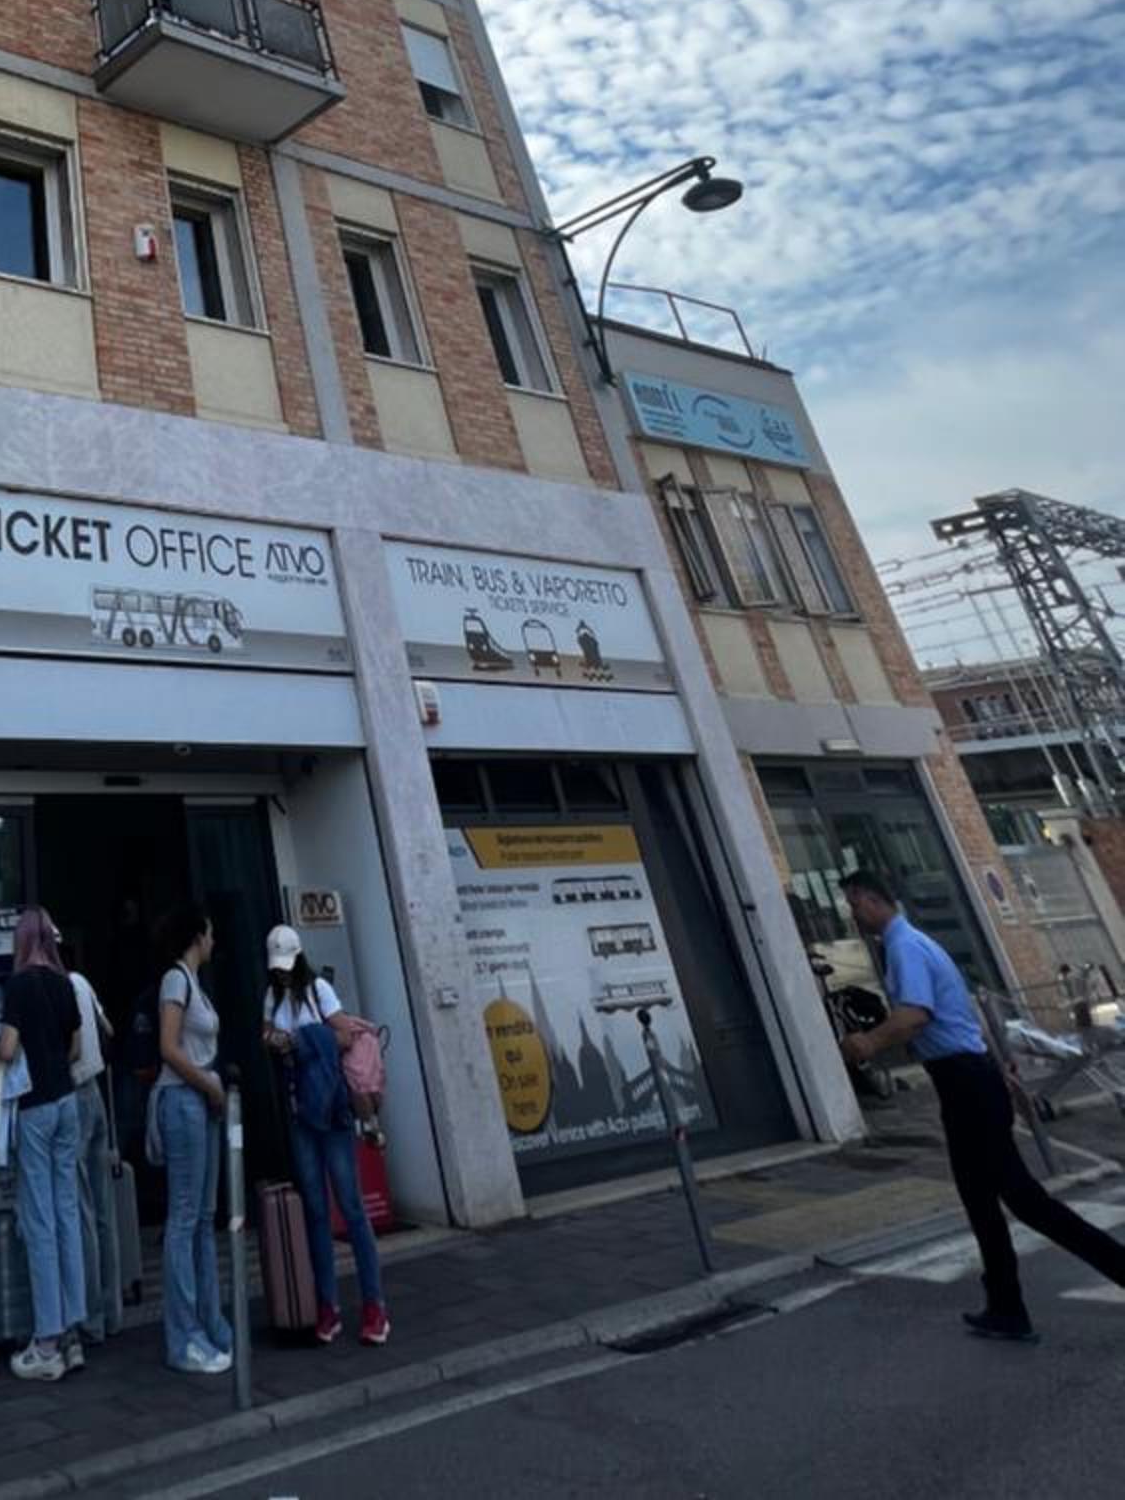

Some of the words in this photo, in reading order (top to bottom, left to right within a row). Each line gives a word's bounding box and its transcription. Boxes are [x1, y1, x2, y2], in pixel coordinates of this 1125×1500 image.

[126, 524, 256, 578] OFFICE
[265, 541, 325, 577] ATVO
[406, 557, 469, 592] TRAIN,
[472, 565, 509, 595] BUS
[510, 570, 525, 595] &
[527, 574, 628, 607] VAPORETTO
[487, 594, 528, 614] TICKETS
[529, 598, 570, 617] SERVICE
